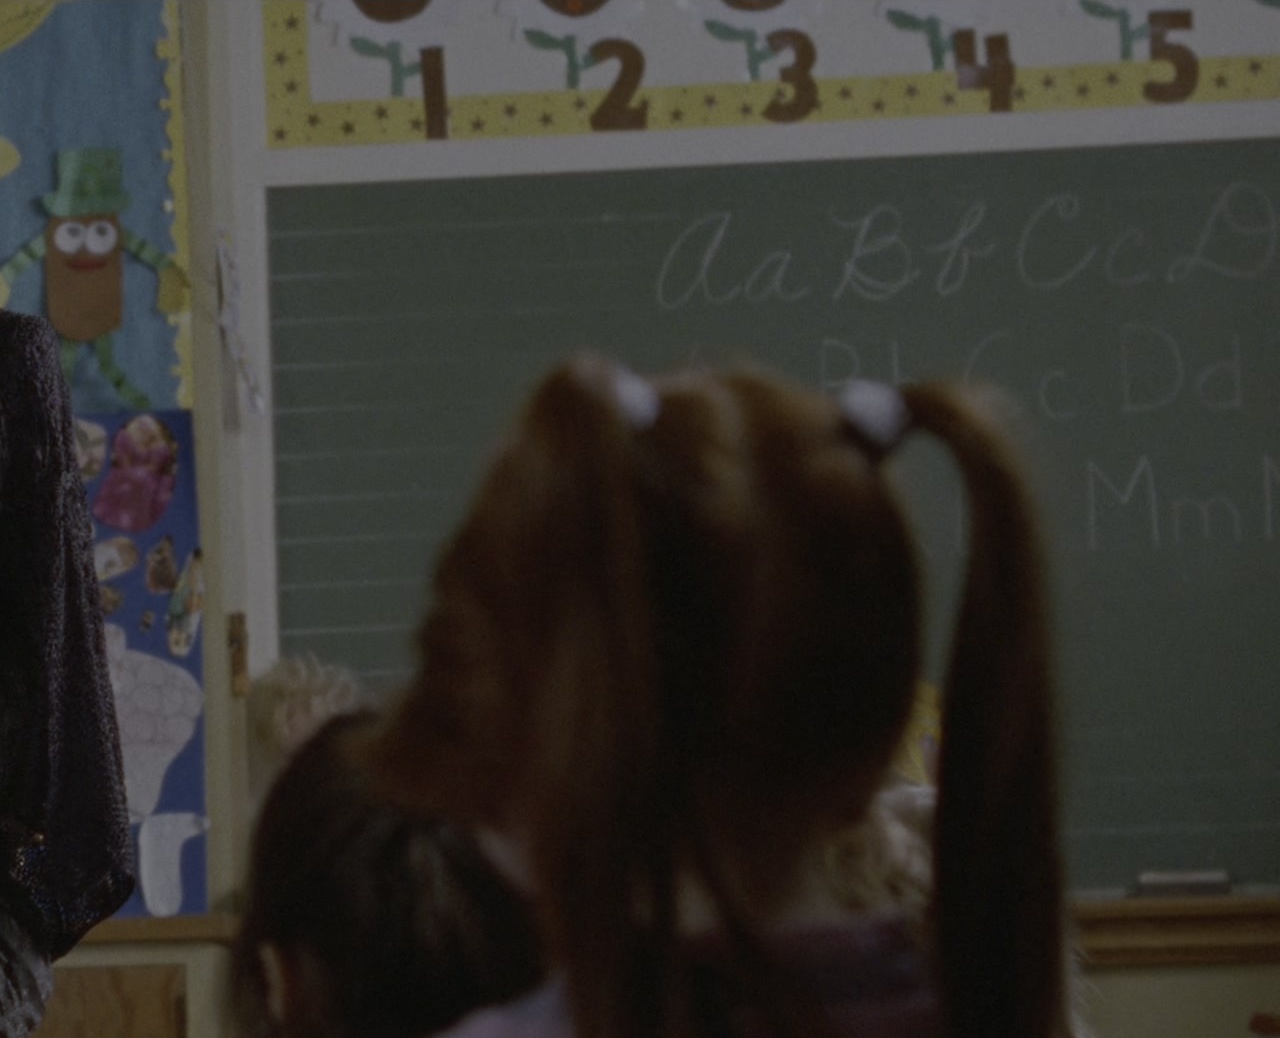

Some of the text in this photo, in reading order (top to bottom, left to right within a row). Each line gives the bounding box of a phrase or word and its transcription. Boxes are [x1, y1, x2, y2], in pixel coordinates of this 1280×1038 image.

[420, 10, 1200, 139] 1 2 3 4 5
[1120, 321, 1244, 415] Dd
[1086, 455, 1244, 549] Mm
